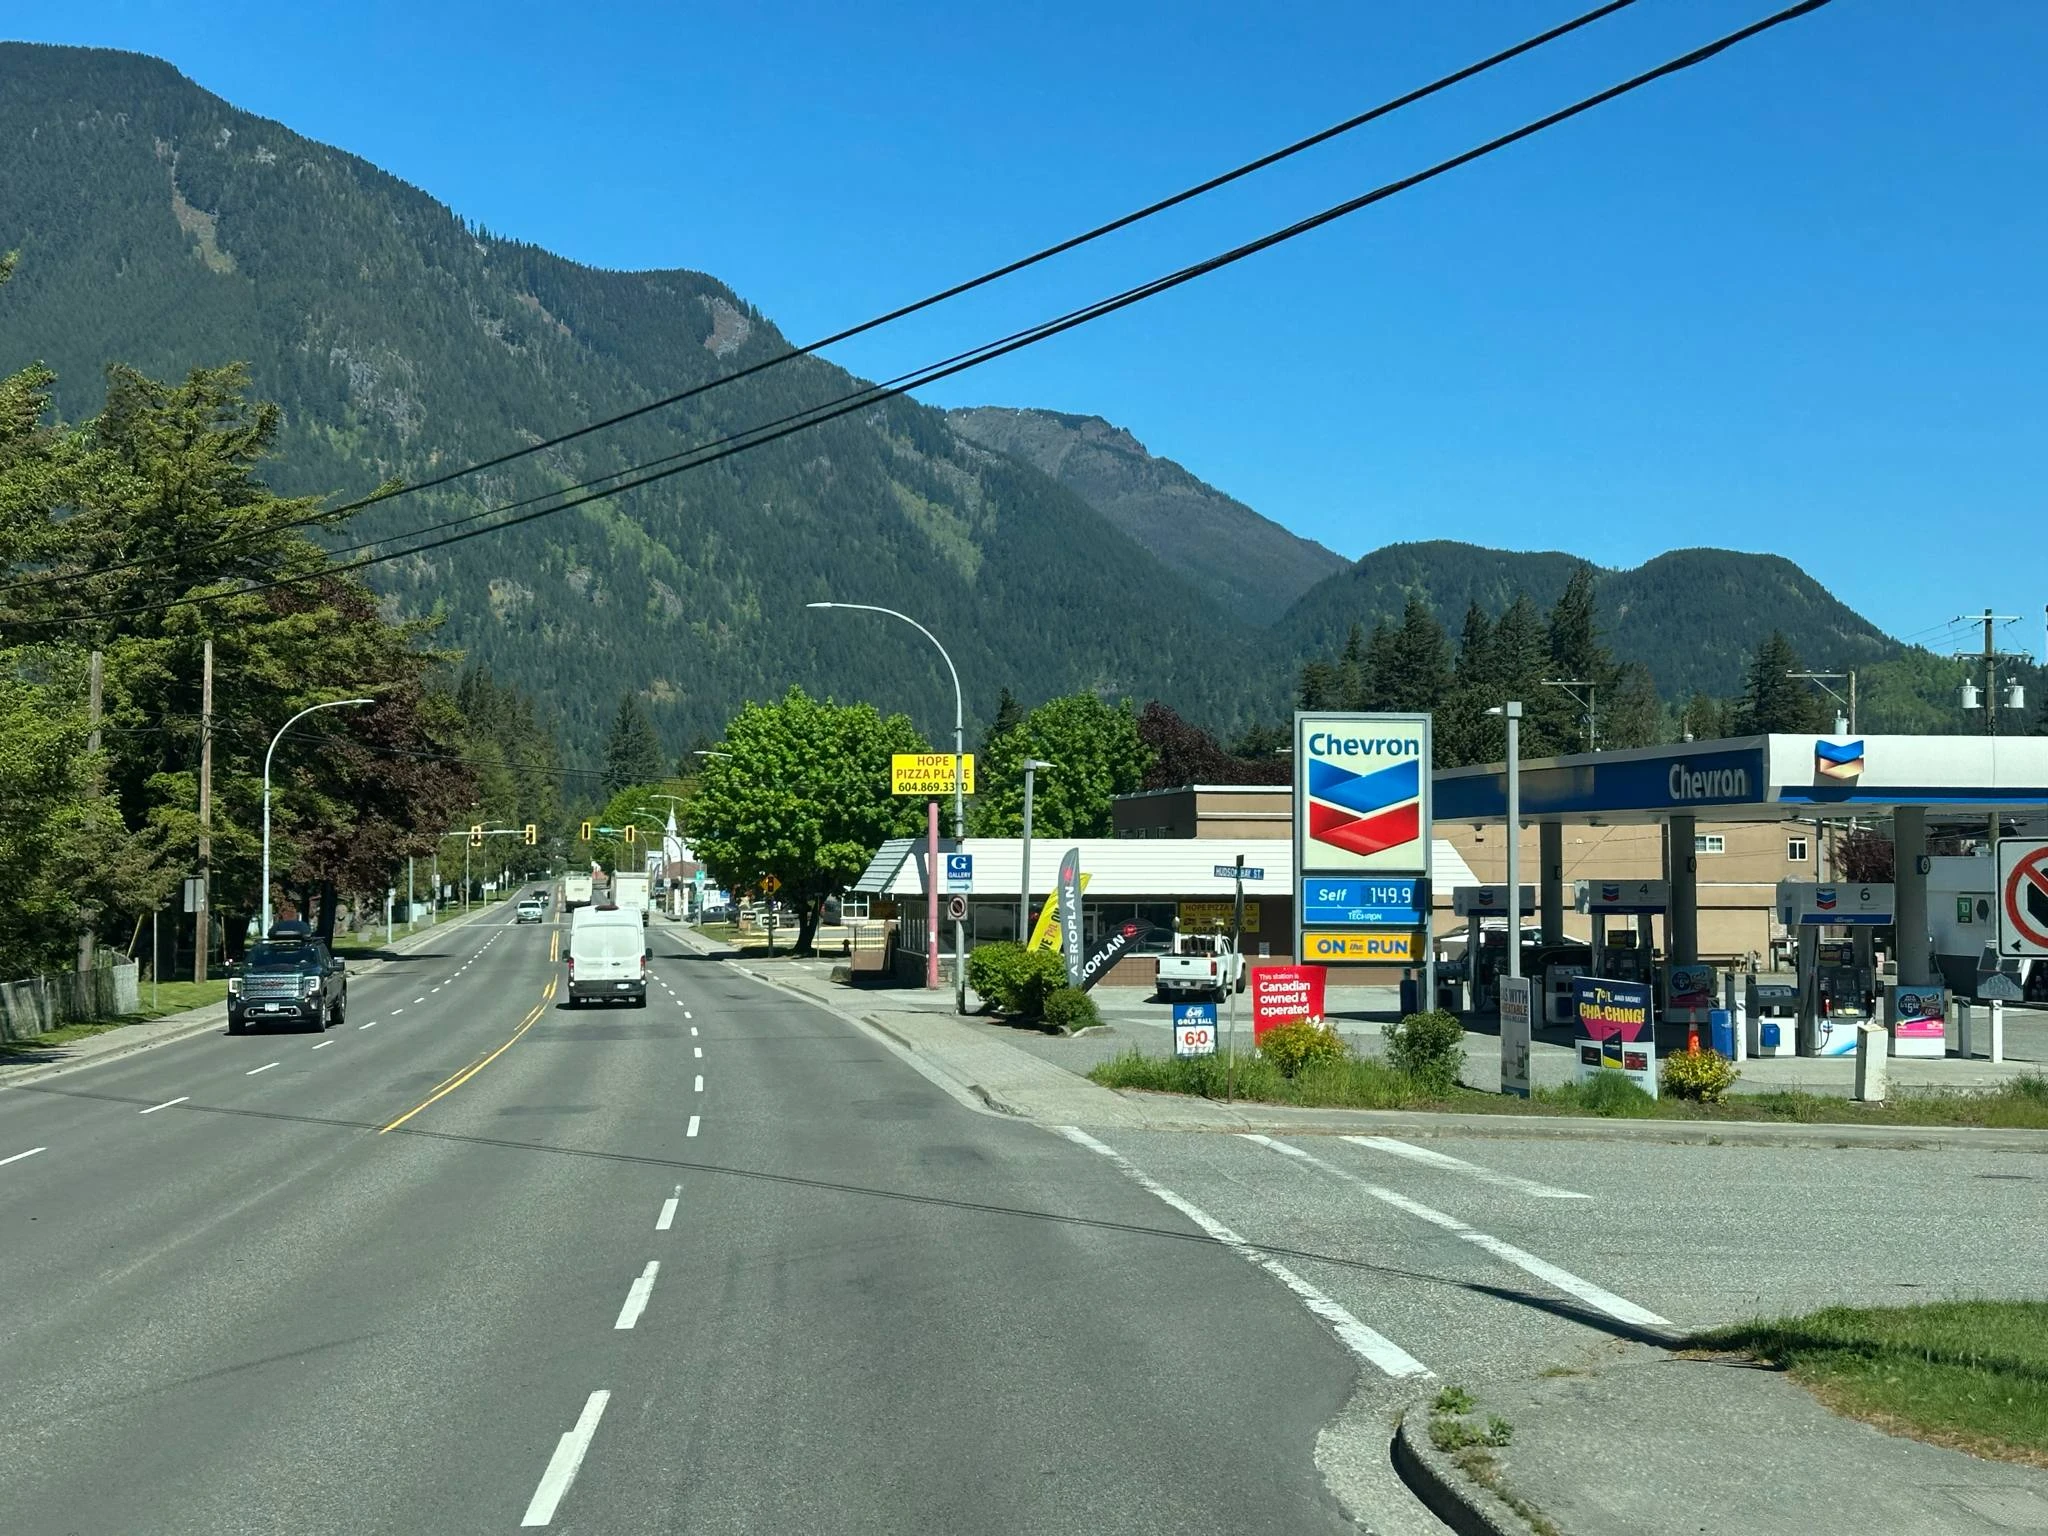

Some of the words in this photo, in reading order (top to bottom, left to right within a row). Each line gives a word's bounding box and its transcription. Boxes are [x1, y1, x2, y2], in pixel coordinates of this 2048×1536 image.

[1309, 733, 1419, 756] Chevron
[917, 756, 949, 766] HOPE
[896, 769, 930, 779] PIZZA
[933, 769, 970, 779] PLAE
[898, 782, 968, 792] 604.869.330
[1669, 764, 1746, 799] Chevron
[951, 856, 968, 870] G
[948, 871, 972, 879] GALLERY
[1318, 888, 1347, 901] Self
[1370, 887, 1411, 904] 149.9
[1639, 883, 1648, 895] 4
[1860, 887, 1871, 901] 6
[1347, 911, 1383, 921] TECHRON
[1064, 886, 1079, 977] AEROPLAN
[1317, 939, 1345, 954] ON
[1368, 939, 1408, 954] RUN
[1259, 980, 1311, 992] Canadian
[1260, 992, 1299, 1003] owned
[1300, 992, 1308, 1002] &
[1260, 1003, 1310, 1017] operated
[1579, 1002, 1646, 1024] CHA-CHING!
